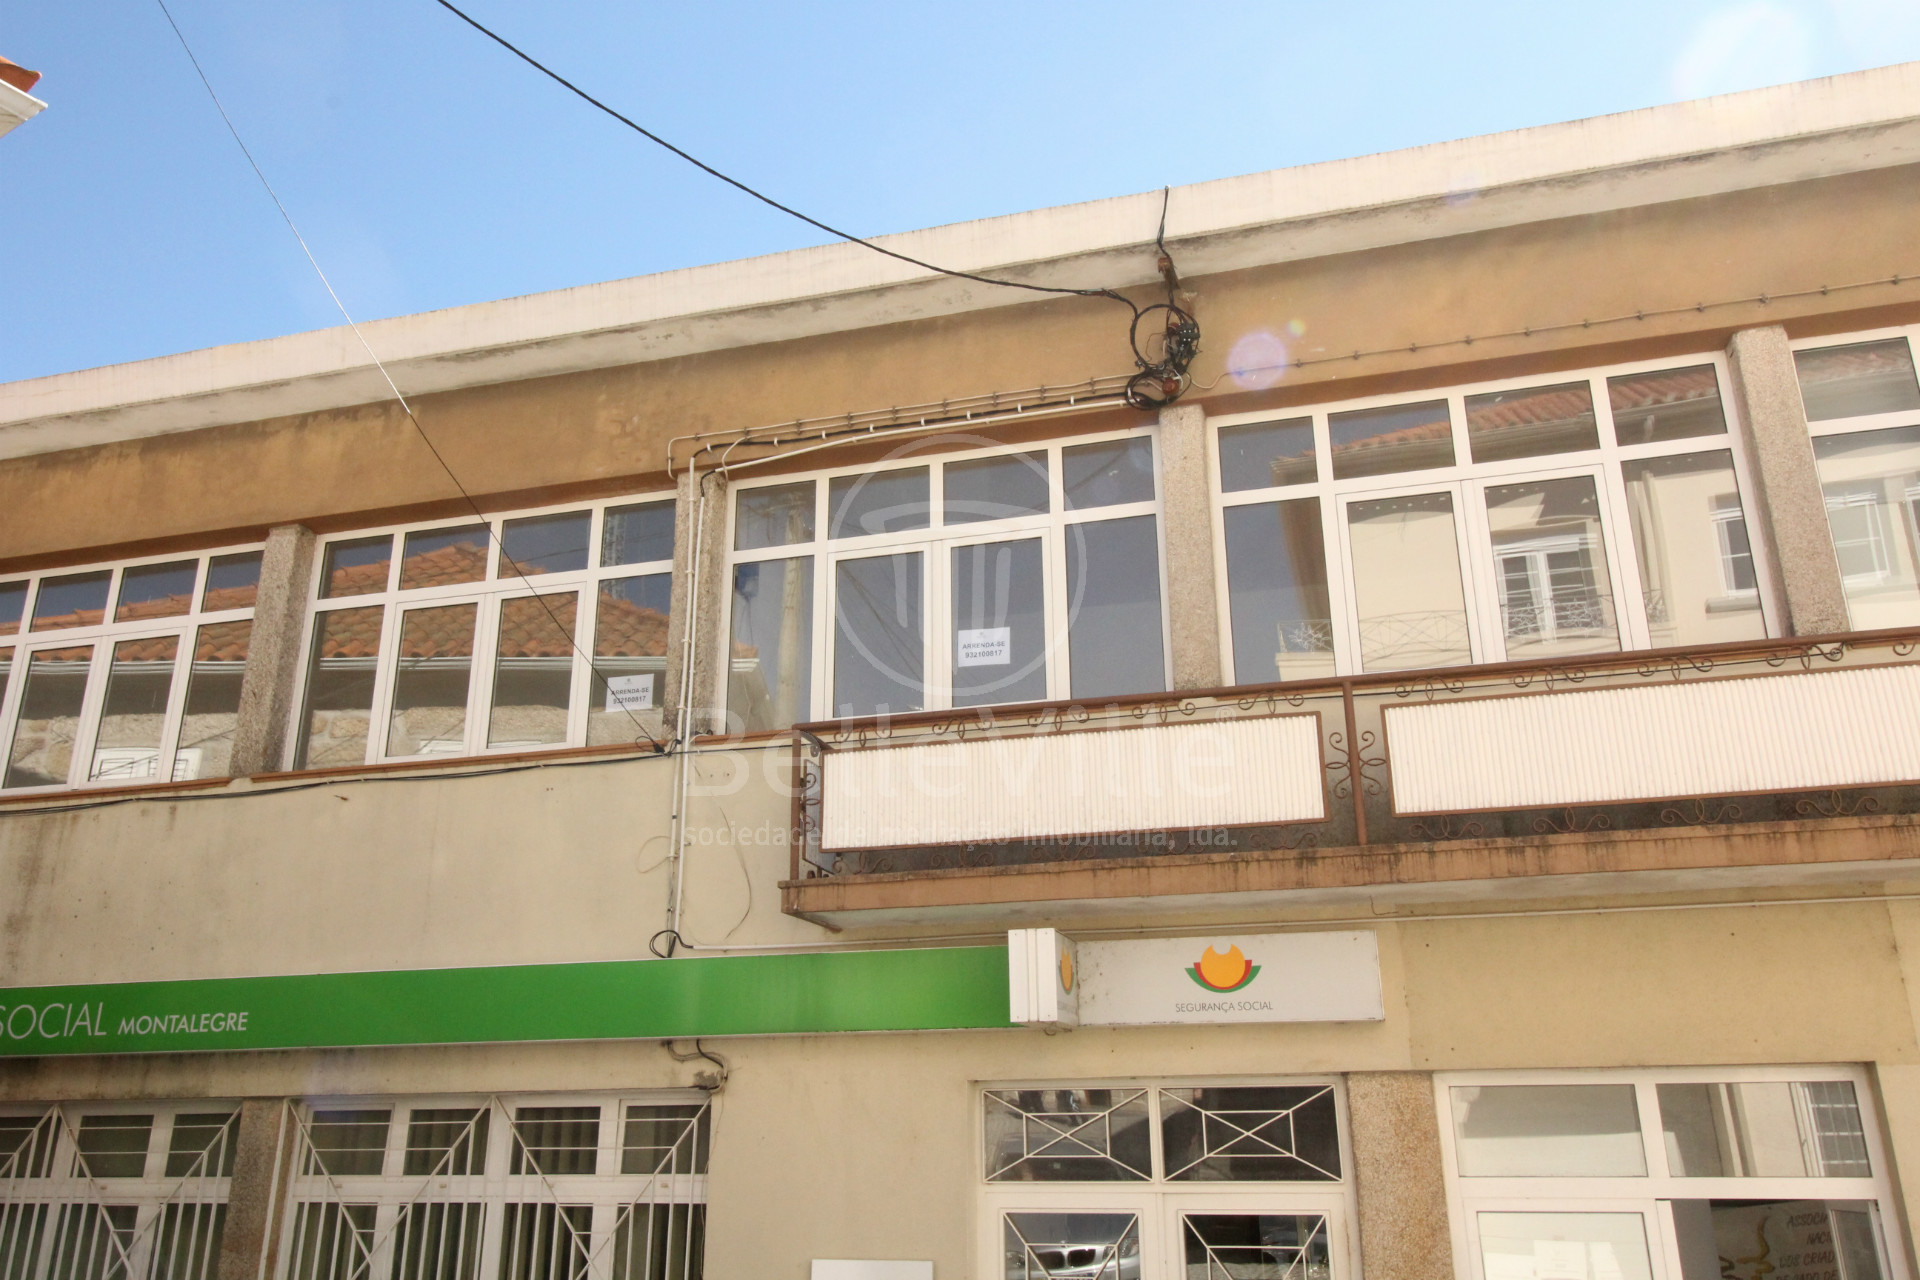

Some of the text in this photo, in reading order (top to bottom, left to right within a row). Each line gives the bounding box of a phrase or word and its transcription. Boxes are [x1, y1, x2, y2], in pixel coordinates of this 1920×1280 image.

[962, 641, 1006, 650] ARRENDA-SE
[611, 687, 650, 696] ARRENDA-SE
[1175, 1001, 1274, 1013] SEGURANÇA SOCIAL
[117, 1012, 249, 1035] MONTALEGRE
